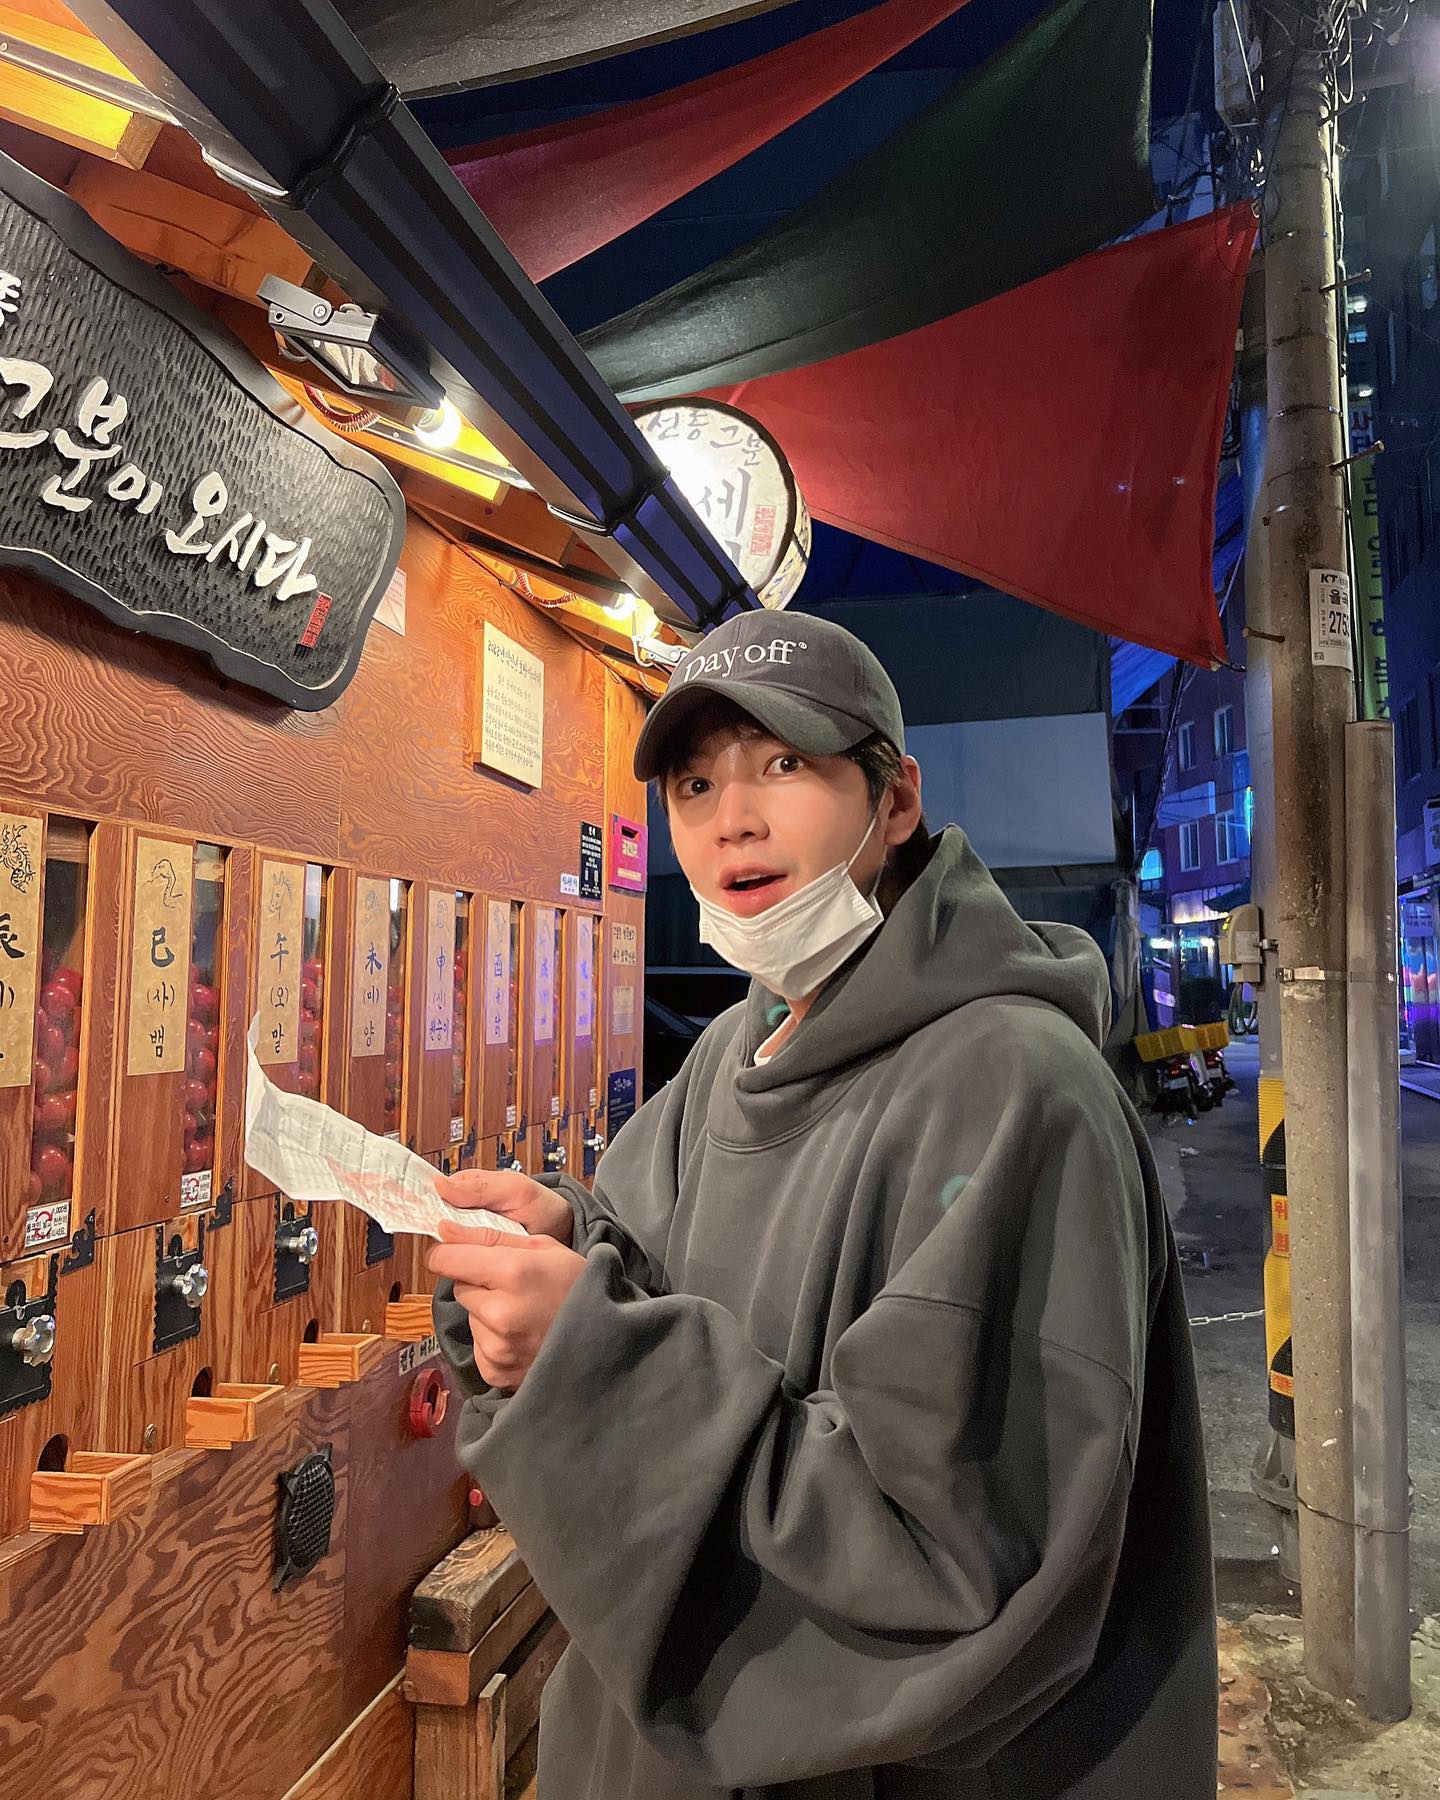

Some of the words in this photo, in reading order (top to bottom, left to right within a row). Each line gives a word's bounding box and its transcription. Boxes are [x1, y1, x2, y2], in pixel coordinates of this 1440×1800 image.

[166, 470, 318, 602] 오시다
[1320, 573, 1338, 584] KT
[683, 645, 741, 683] Day
[270, 931, 290, 975] 午
[149, 1023, 166, 1059] 뱀
